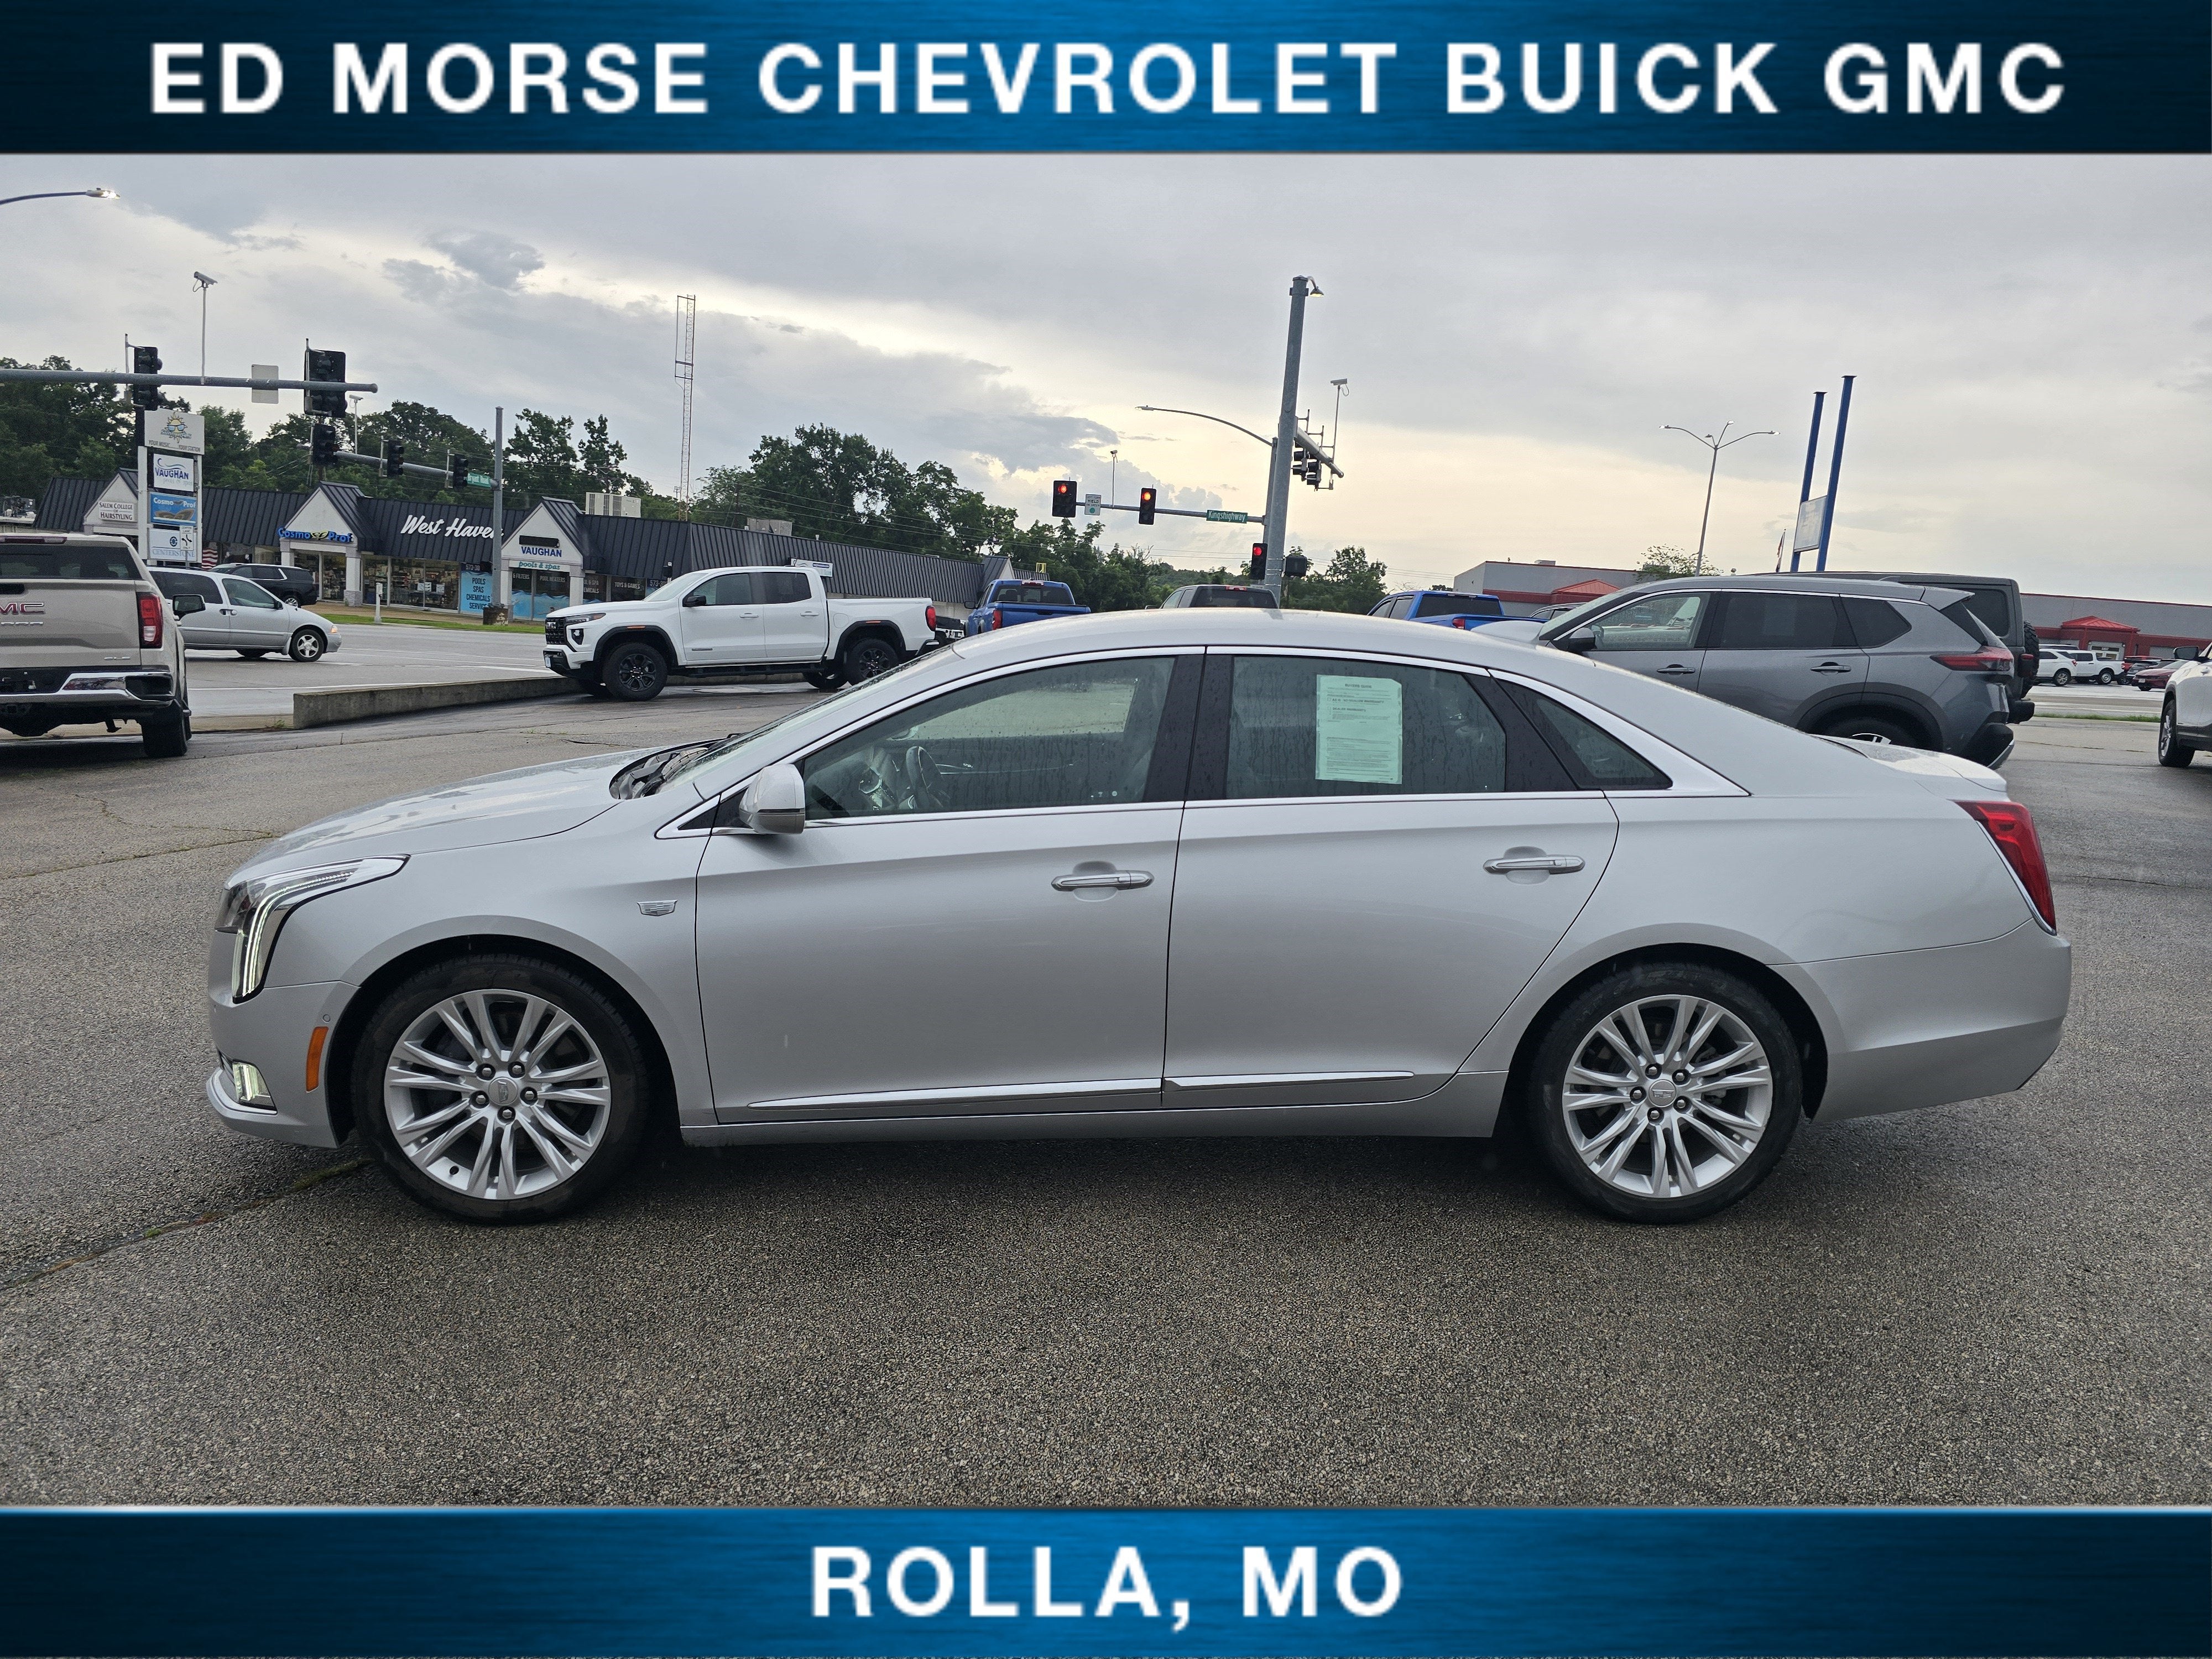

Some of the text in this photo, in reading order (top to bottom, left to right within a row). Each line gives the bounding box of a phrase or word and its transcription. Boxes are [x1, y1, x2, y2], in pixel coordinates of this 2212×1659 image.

[155, 467, 189, 479] VAUGHAN
[153, 497, 174, 505] Cosmo
[100, 512, 133, 520] HAIRSTYLING
[1208, 510, 1246, 523] Kingshighway
[400, 514, 445, 535] West
[278, 526, 353, 542] Cosmo Prof
[521, 546, 562, 557] VAUGHAN
[466, 594, 491, 602] CHEMICALS
[0, 602, 44, 615] MC
